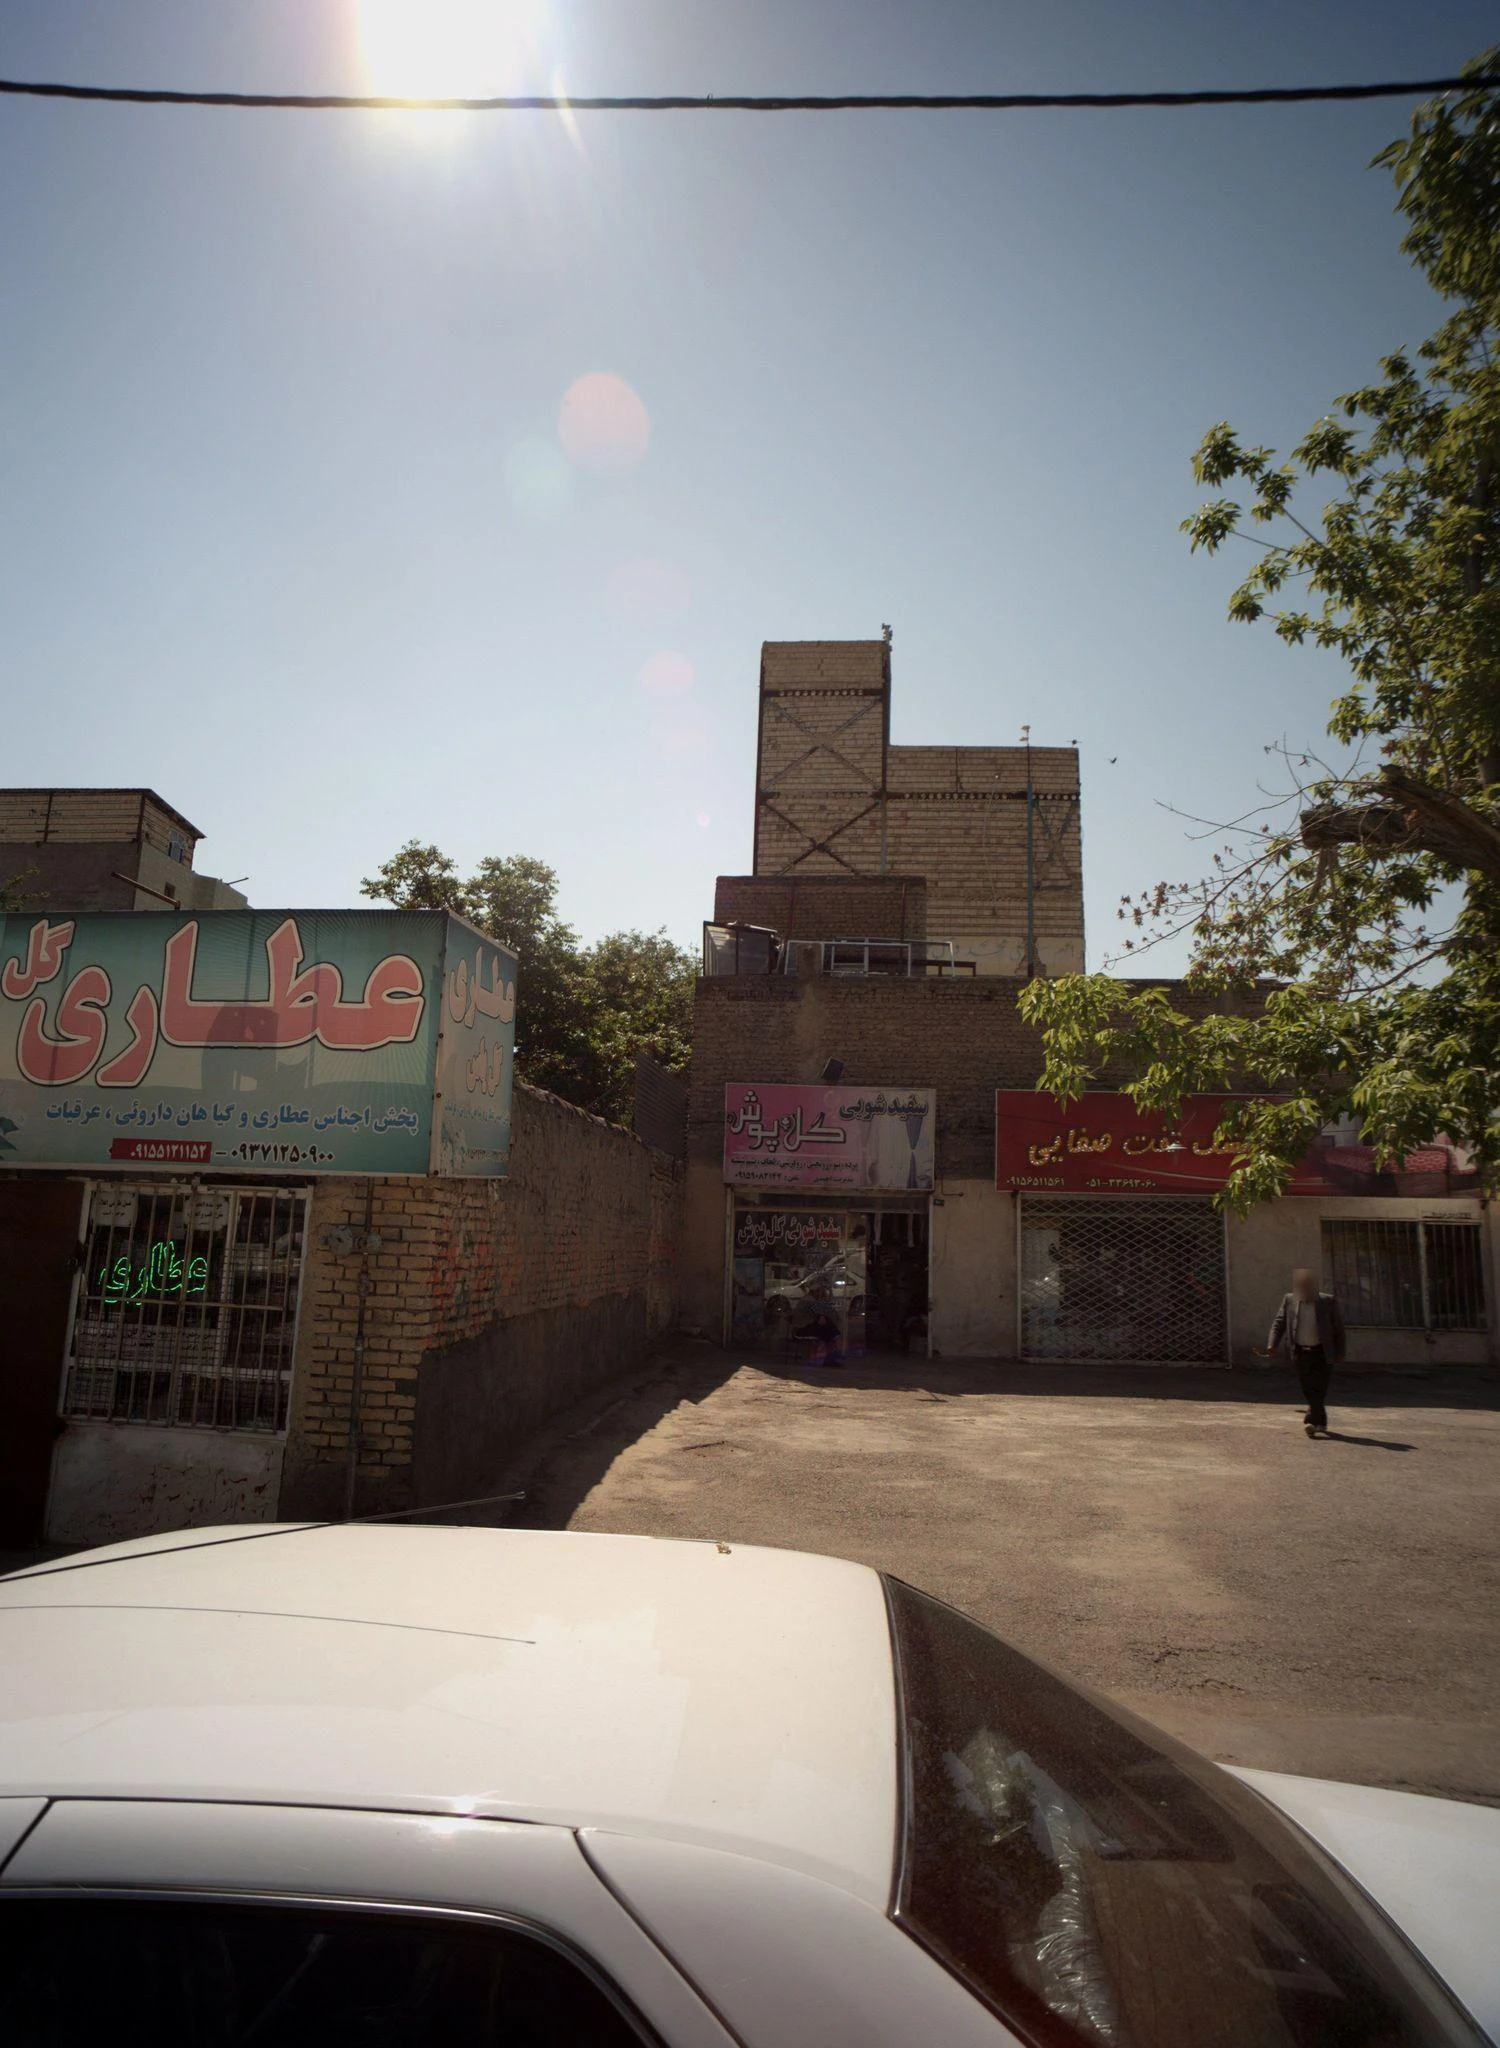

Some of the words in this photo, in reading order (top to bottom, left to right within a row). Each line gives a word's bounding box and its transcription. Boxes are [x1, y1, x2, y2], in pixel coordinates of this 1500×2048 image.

[1, 918, 76, 999] گل
[16, 918, 425, 1087] عطاری
[449, 946, 514, 1030] عطاری
[46, 1100, 101, 1126] عرقیات
[238, 1111, 249, 1129] و
[252, 1103, 311, 1129] عطاری
[314, 1105, 371, 1131] اجناس
[373, 1106, 419, 1136] پخش
[729, 1089, 779, 1152] پوش
[97, 1240, 210, 1307] عطاری
